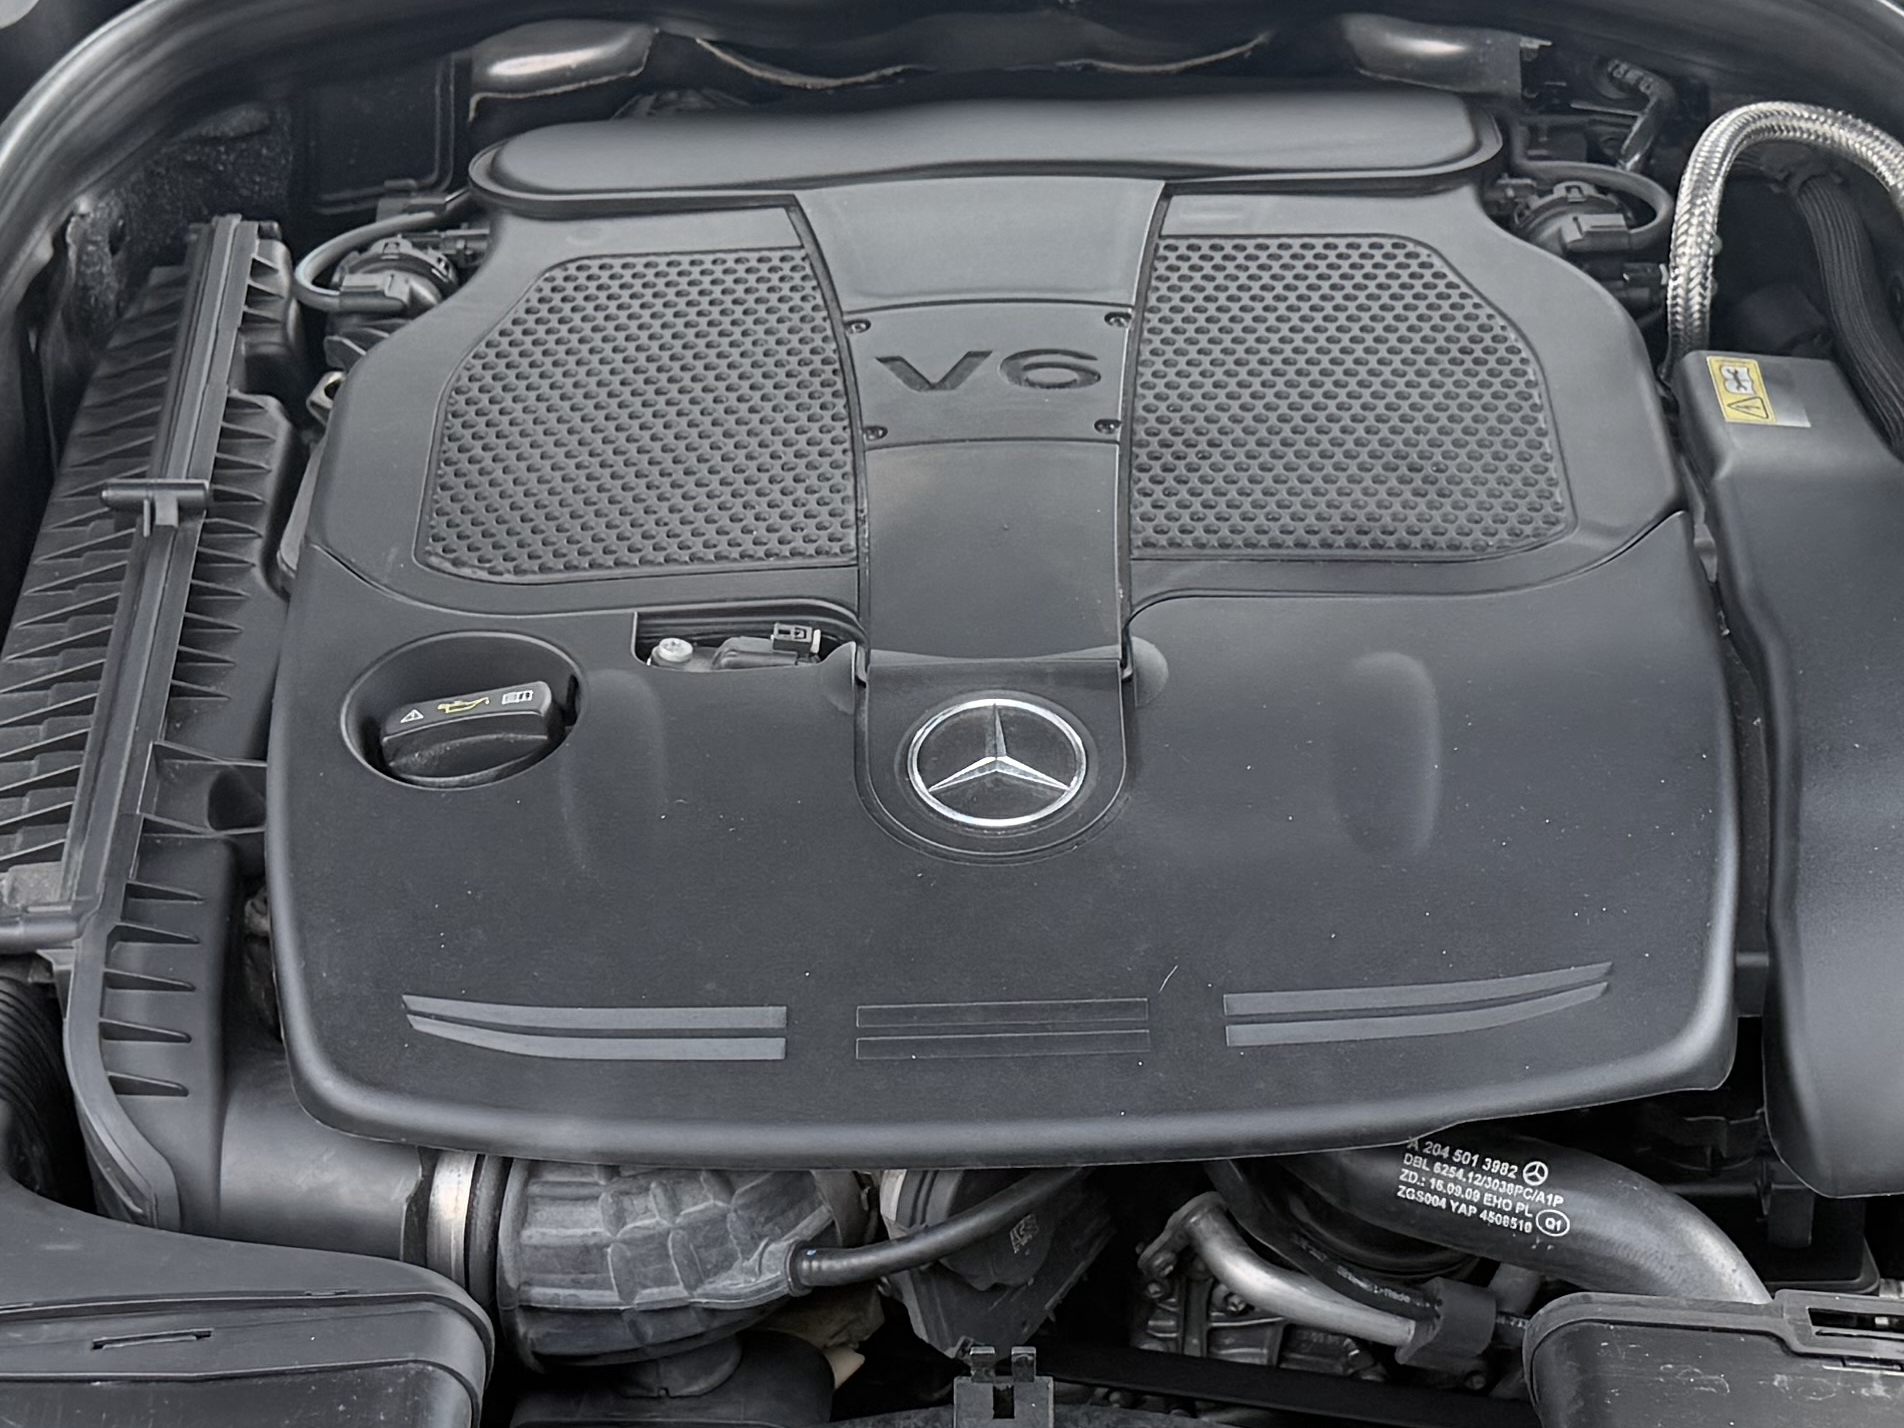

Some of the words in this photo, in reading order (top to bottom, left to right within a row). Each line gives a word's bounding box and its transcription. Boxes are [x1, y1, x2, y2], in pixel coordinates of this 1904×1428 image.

[875, 349, 1101, 392] V6
[1403, 1153, 1430, 1171] DBL
[1423, 1141, 1450, 1159] 204
[1452, 1149, 1480, 1167] 501
[1482, 1158, 1519, 1179] 3982
[1397, 1185, 1446, 1209] ZGS004
[1450, 1200, 1477, 1218] YAP
[1483, 1193, 1513, 1211] EHO
[1515, 1202, 1533, 1217] PL
[1545, 1217, 1562, 1232] Q1
